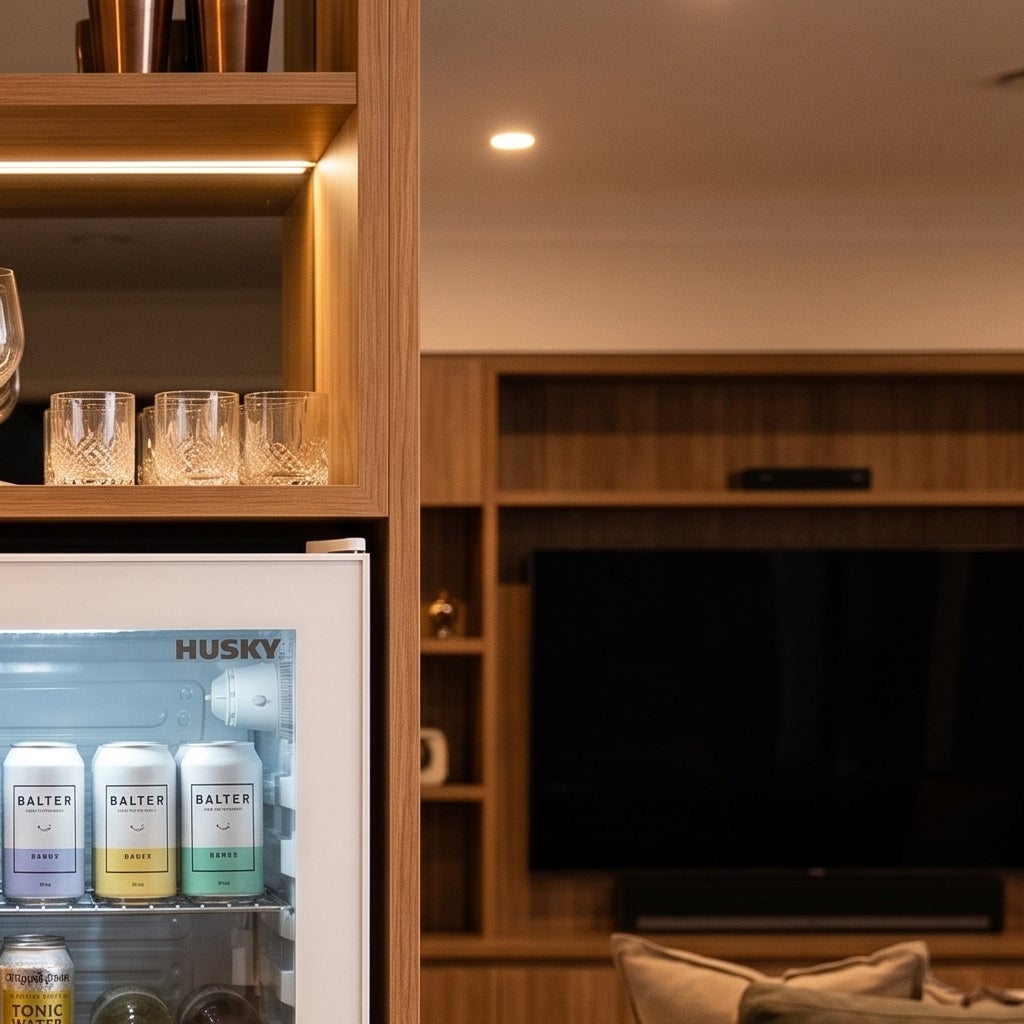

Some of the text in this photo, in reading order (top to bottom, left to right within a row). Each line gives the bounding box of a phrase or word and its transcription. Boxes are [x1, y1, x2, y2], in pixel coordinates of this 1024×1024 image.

[176, 638, 281, 660] HUSKY
[18, 795, 72, 806] BALTER
[110, 795, 164, 806] BALTER
[195, 793, 250, 805] BALTER
[11, 1004, 63, 1018] TONIC
